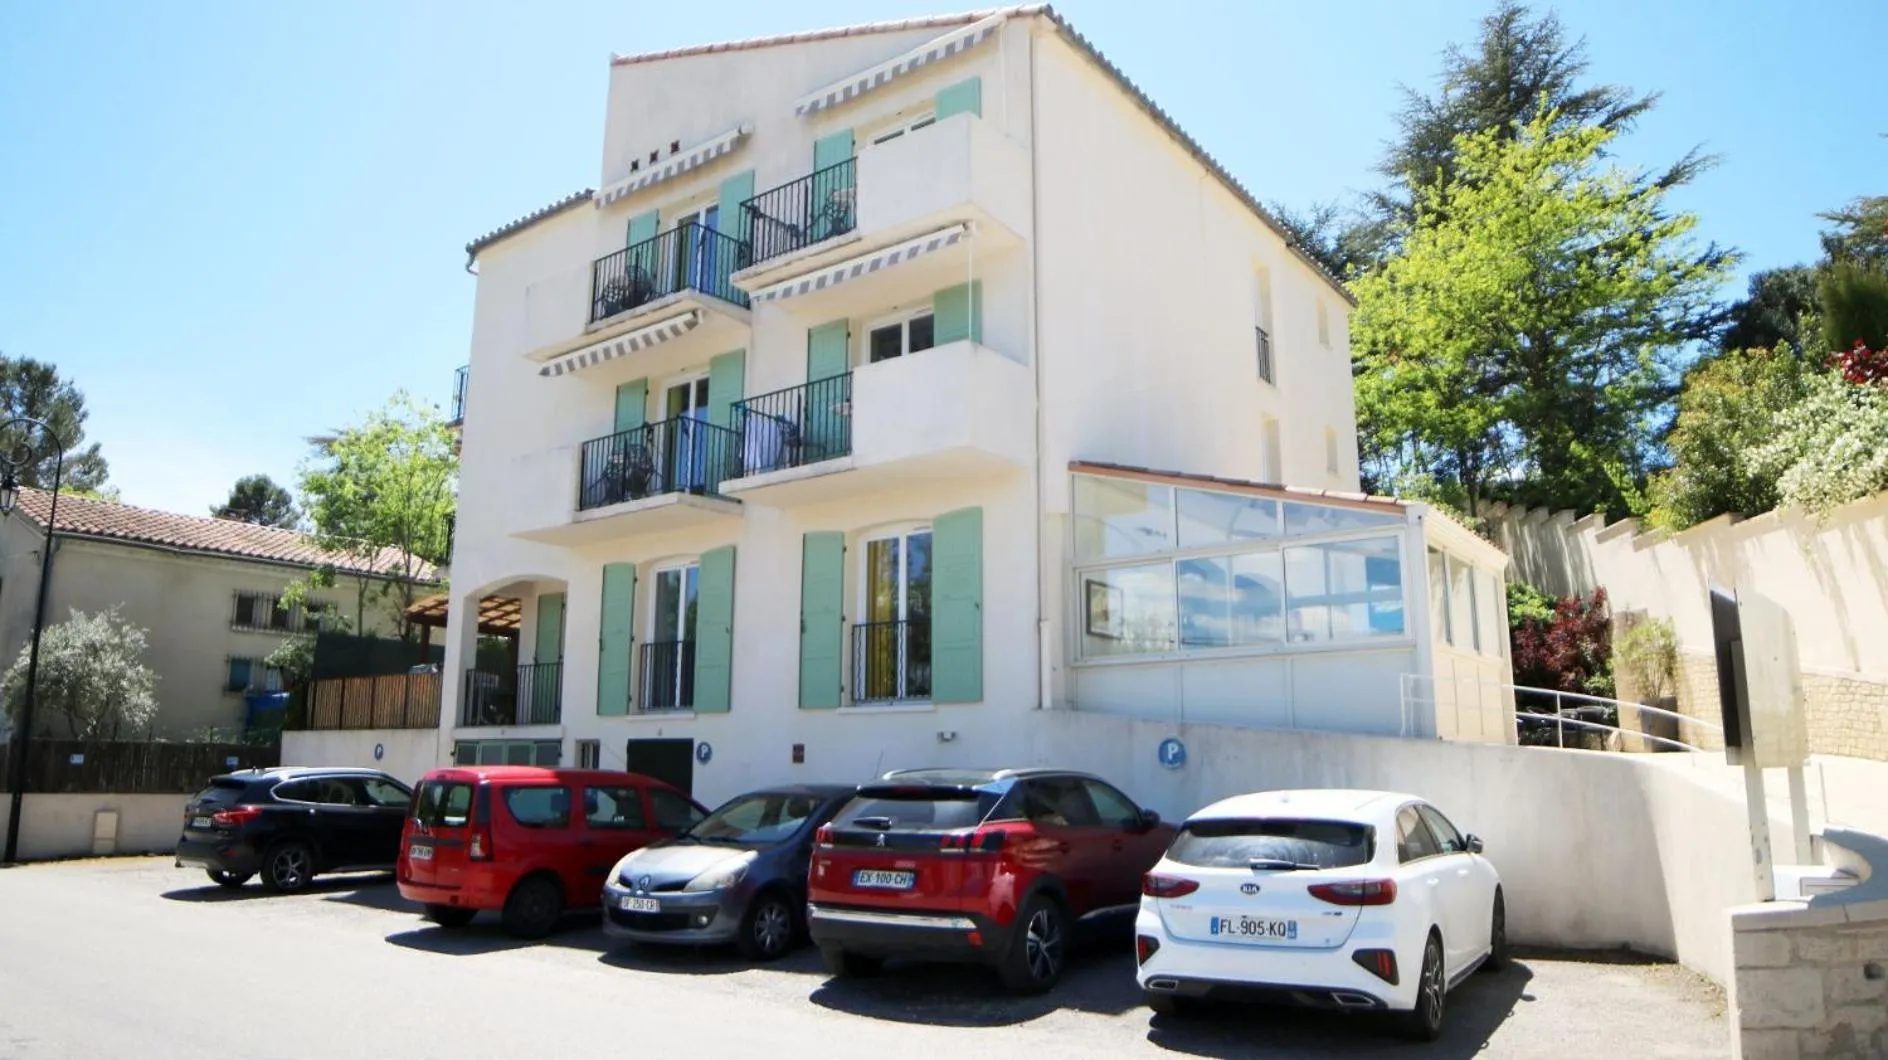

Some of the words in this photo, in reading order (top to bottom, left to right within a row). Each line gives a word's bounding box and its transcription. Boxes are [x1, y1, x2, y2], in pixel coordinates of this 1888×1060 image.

[701, 744, 709, 758] P
[1167, 743, 1179, 760] P
[1242, 884, 1258, 894] KIA
